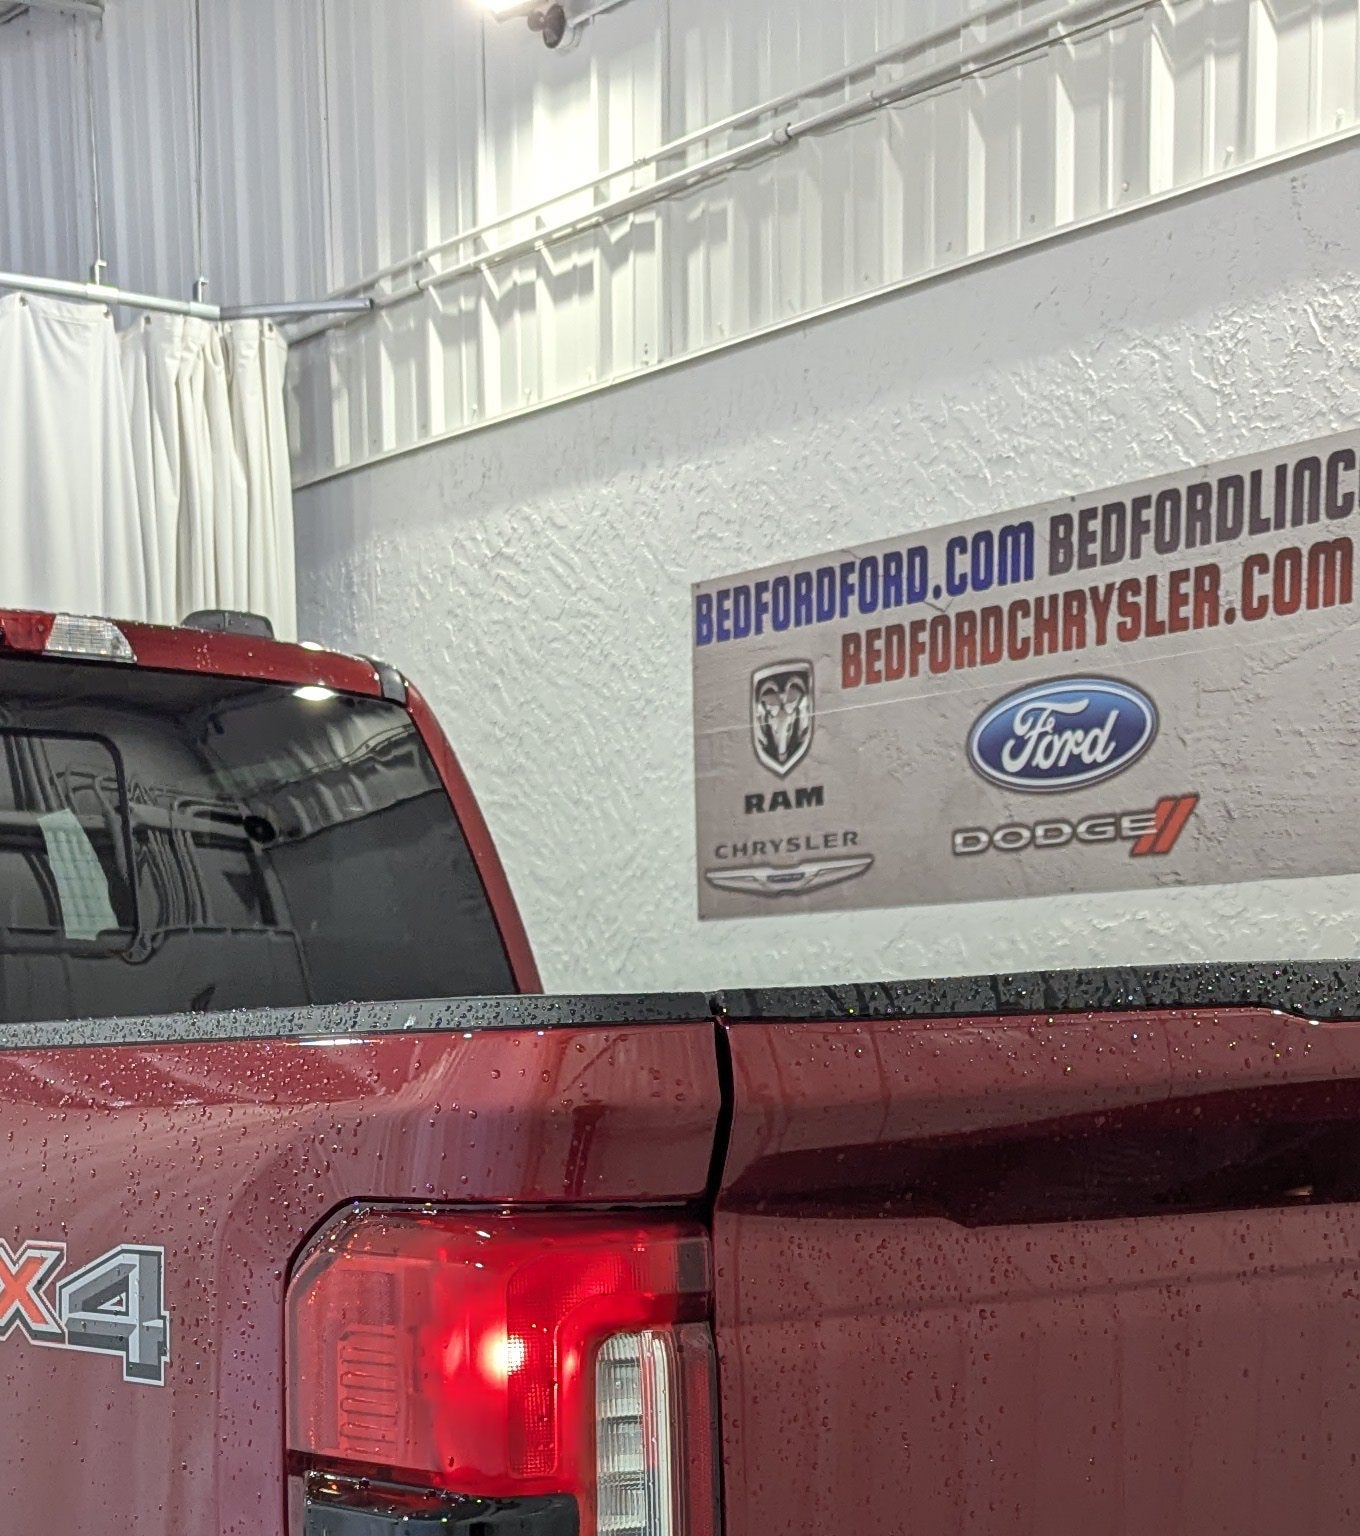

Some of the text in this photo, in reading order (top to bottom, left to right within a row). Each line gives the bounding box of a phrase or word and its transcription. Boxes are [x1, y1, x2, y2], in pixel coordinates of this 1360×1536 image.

[695, 520, 1035, 647] BEDFORDFORD.COM
[841, 537, 1354, 689] BEDFORDCHRYSLER.COM
[1001, 698, 1120, 773] Ford
[743, 785, 825, 815] RAM
[714, 830, 860, 860] CHRYSLER
[952, 810, 1159, 856] DODGE
